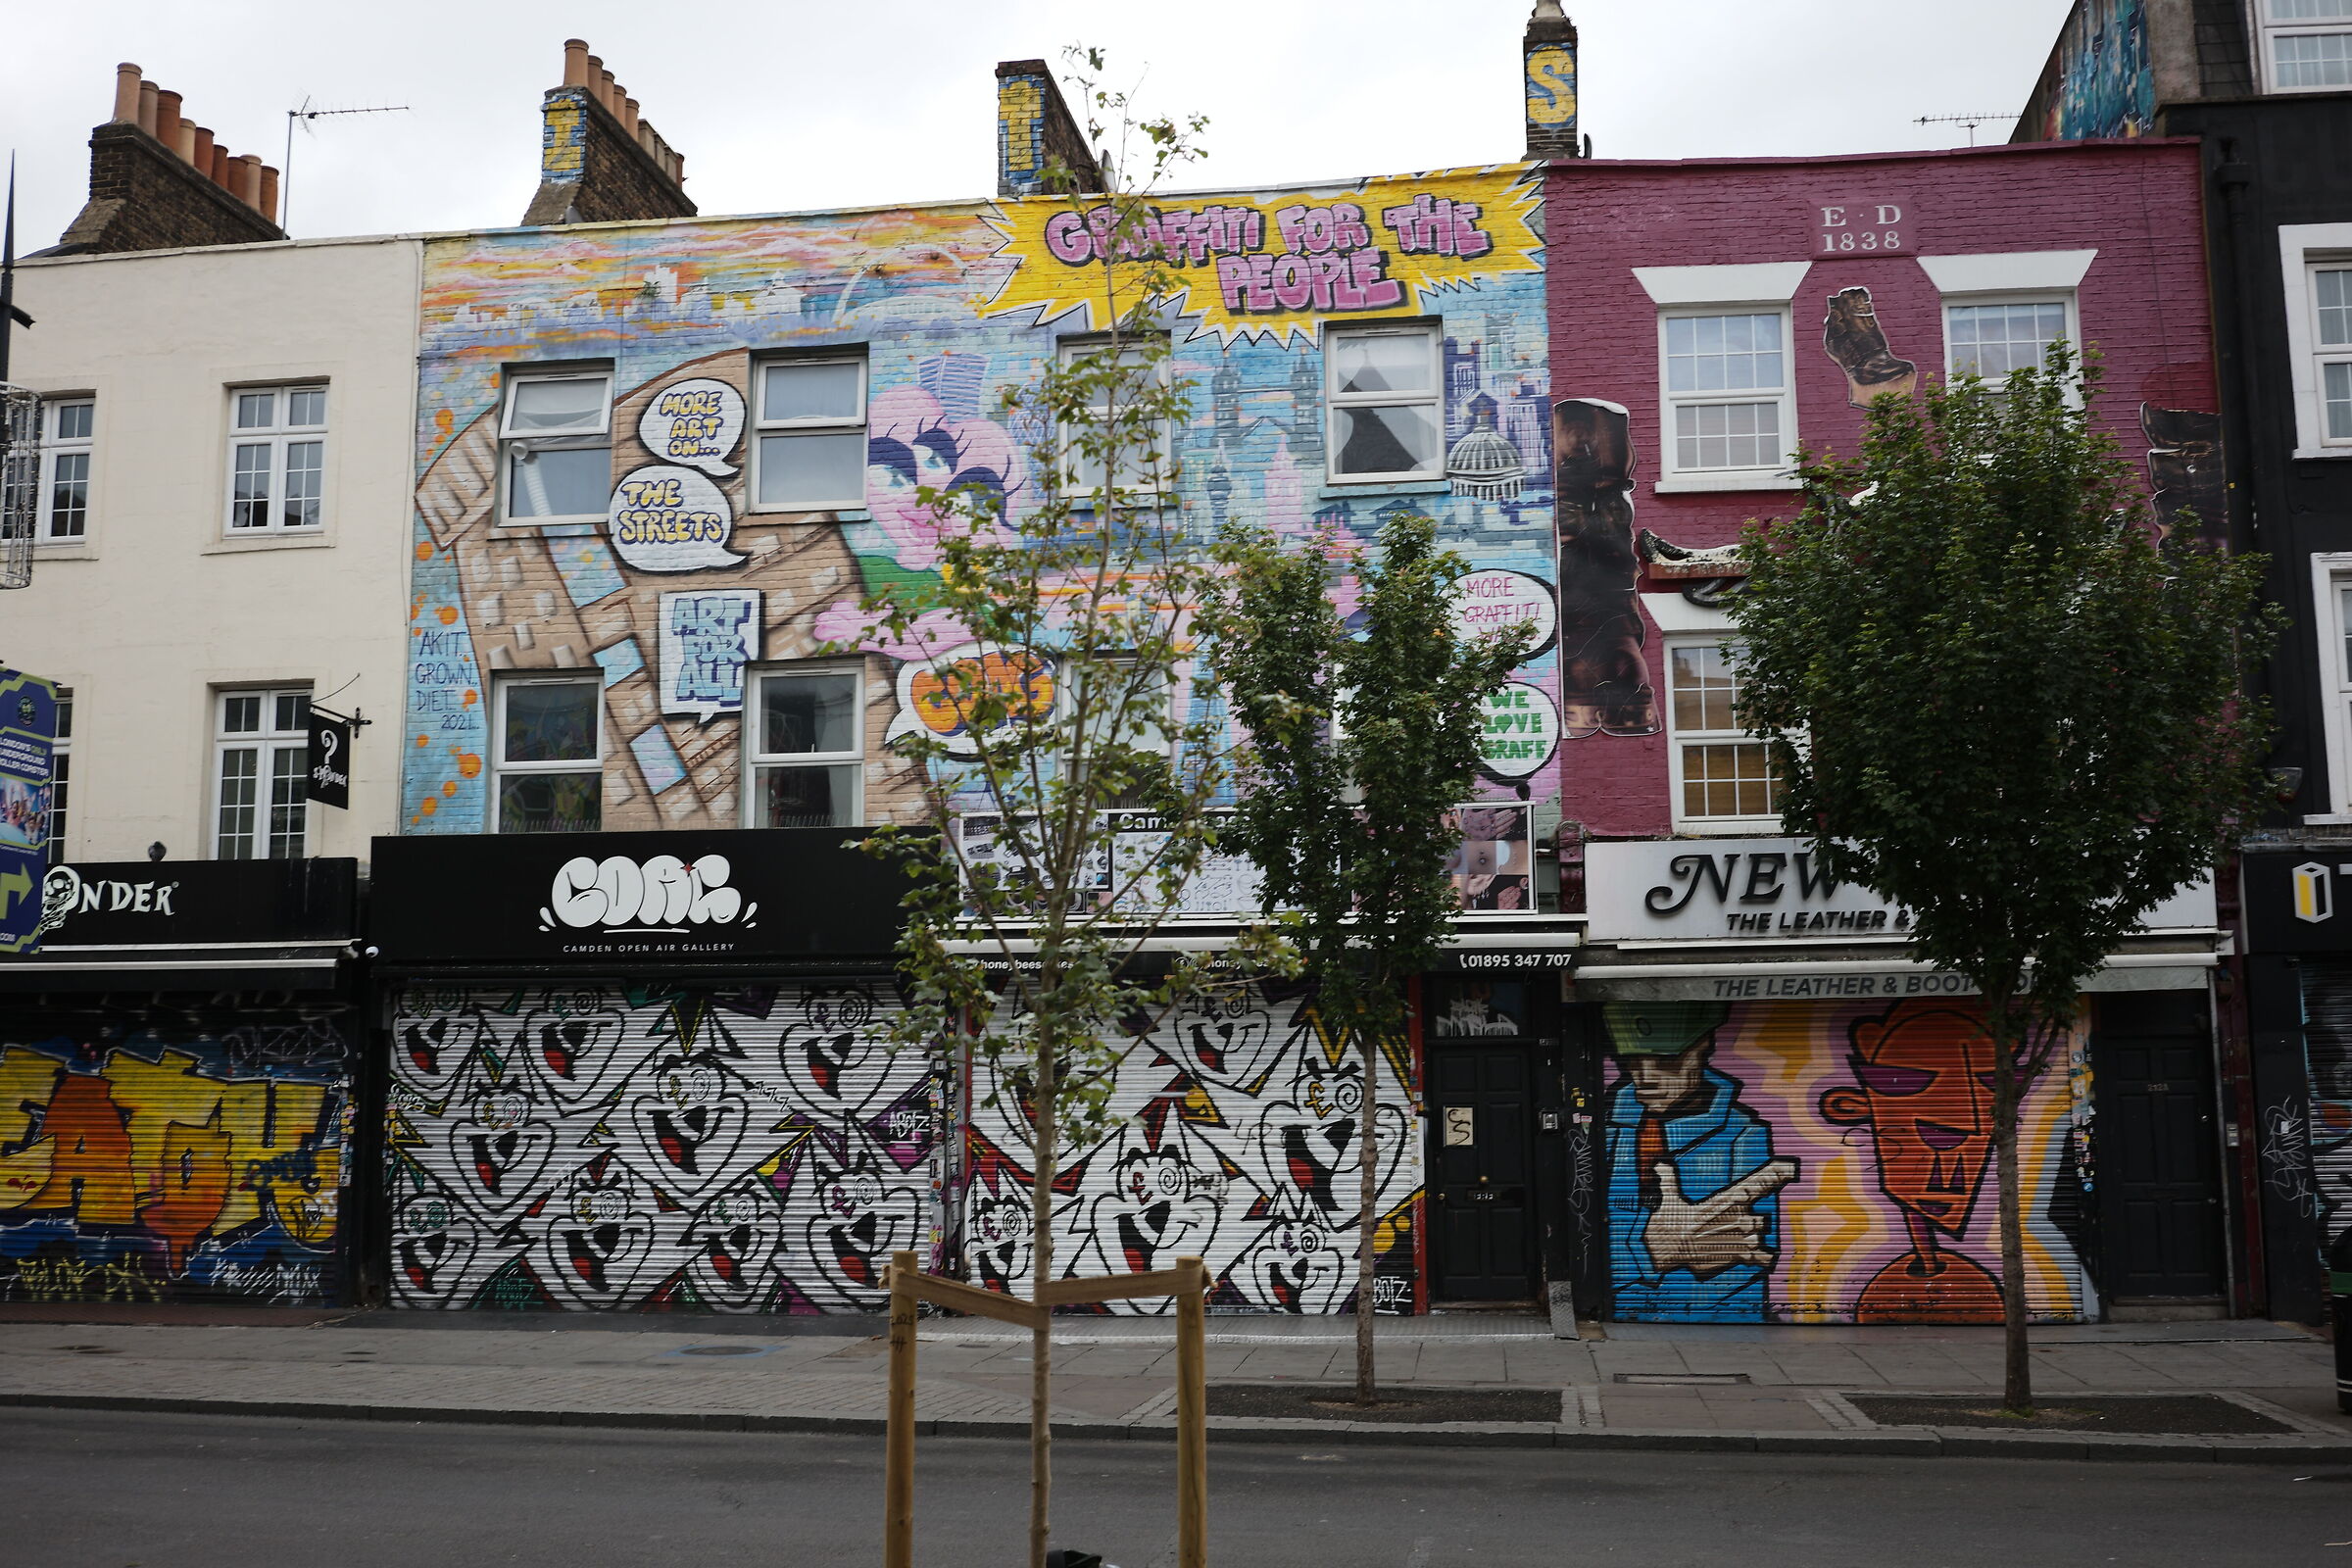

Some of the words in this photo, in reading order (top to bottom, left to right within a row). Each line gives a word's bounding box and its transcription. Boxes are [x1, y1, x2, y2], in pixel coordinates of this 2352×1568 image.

[1045, 205, 1265, 268] GRAFFITI
[1275, 203, 1371, 256] FOR
[1384, 194, 1493, 260] THE
[1823, 230, 1900, 251] 1838
[1216, 248, 1410, 315] PEOPLE
[661, 390, 722, 416] MORE
[669, 416, 723, 440] ART
[668, 439, 720, 457] ON...
[620, 478, 684, 509] THE
[617, 509, 724, 544] STREETS
[1466, 577, 1514, 597] MORE
[672, 598, 752, 637] ART
[1464, 603, 1541, 622] GRAFFITI
[682, 635, 750, 664] FOR
[675, 662, 743, 708] ALL
[416, 690, 457, 711] DIET
[1487, 690, 1530, 709] WE
[1486, 739, 1547, 760] GRAFF
[1727, 912, 1771, 931] THE
[1779, 909, 1887, 931] LEATHER
[563, 945, 612, 954] CAMDEN
[618, 944, 651, 953] OPEN
[656, 944, 676, 953] AIR
[682, 943, 735, 953] GALLERY
[1468, 954, 1510, 968] 01895
[1514, 954, 1541, 967] 347
[1544, 954, 1572, 966] 707
[1715, 978, 1758, 998] THE
[1766, 976, 1876, 997] LEATHER
[1882, 976, 1898, 994] &
